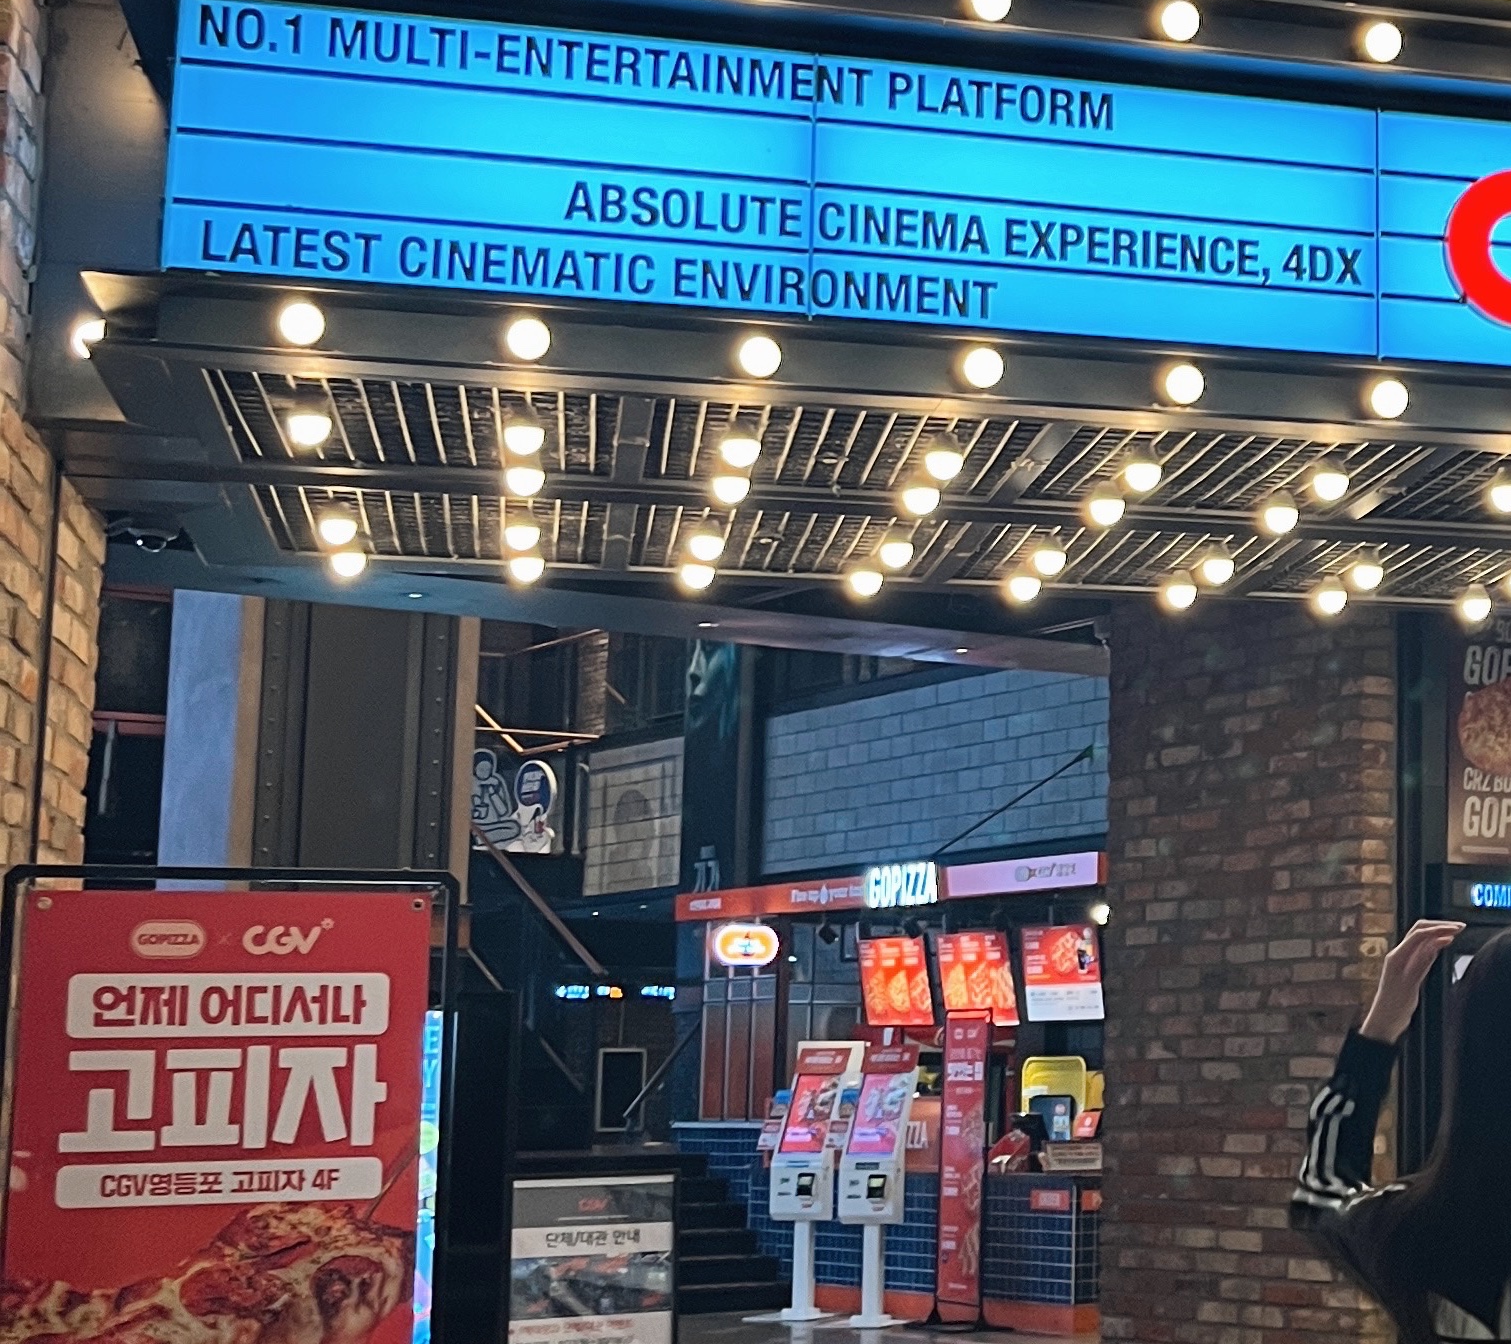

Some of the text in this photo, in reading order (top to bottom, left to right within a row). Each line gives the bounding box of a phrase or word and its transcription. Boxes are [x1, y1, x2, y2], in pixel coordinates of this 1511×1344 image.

[198, 3, 1115, 132] NO.1 MULTI-ENTERTAINMENT PLATFORM
[202, 218, 999, 321] LATEST CINEMATIC ENVIRONMENT
[564, 179, 1363, 287] ABSOLUTE CINEMA EXPERIENCE, 4DX
[867, 860, 939, 909] GOPIZZA
[242, 924, 322, 956] CGV
[92, 983, 368, 1028] 언제 어디서나
[58, 1043, 388, 1154] 고피자
[99, 1167, 341, 1198] CGV영등포 고피자 4F
